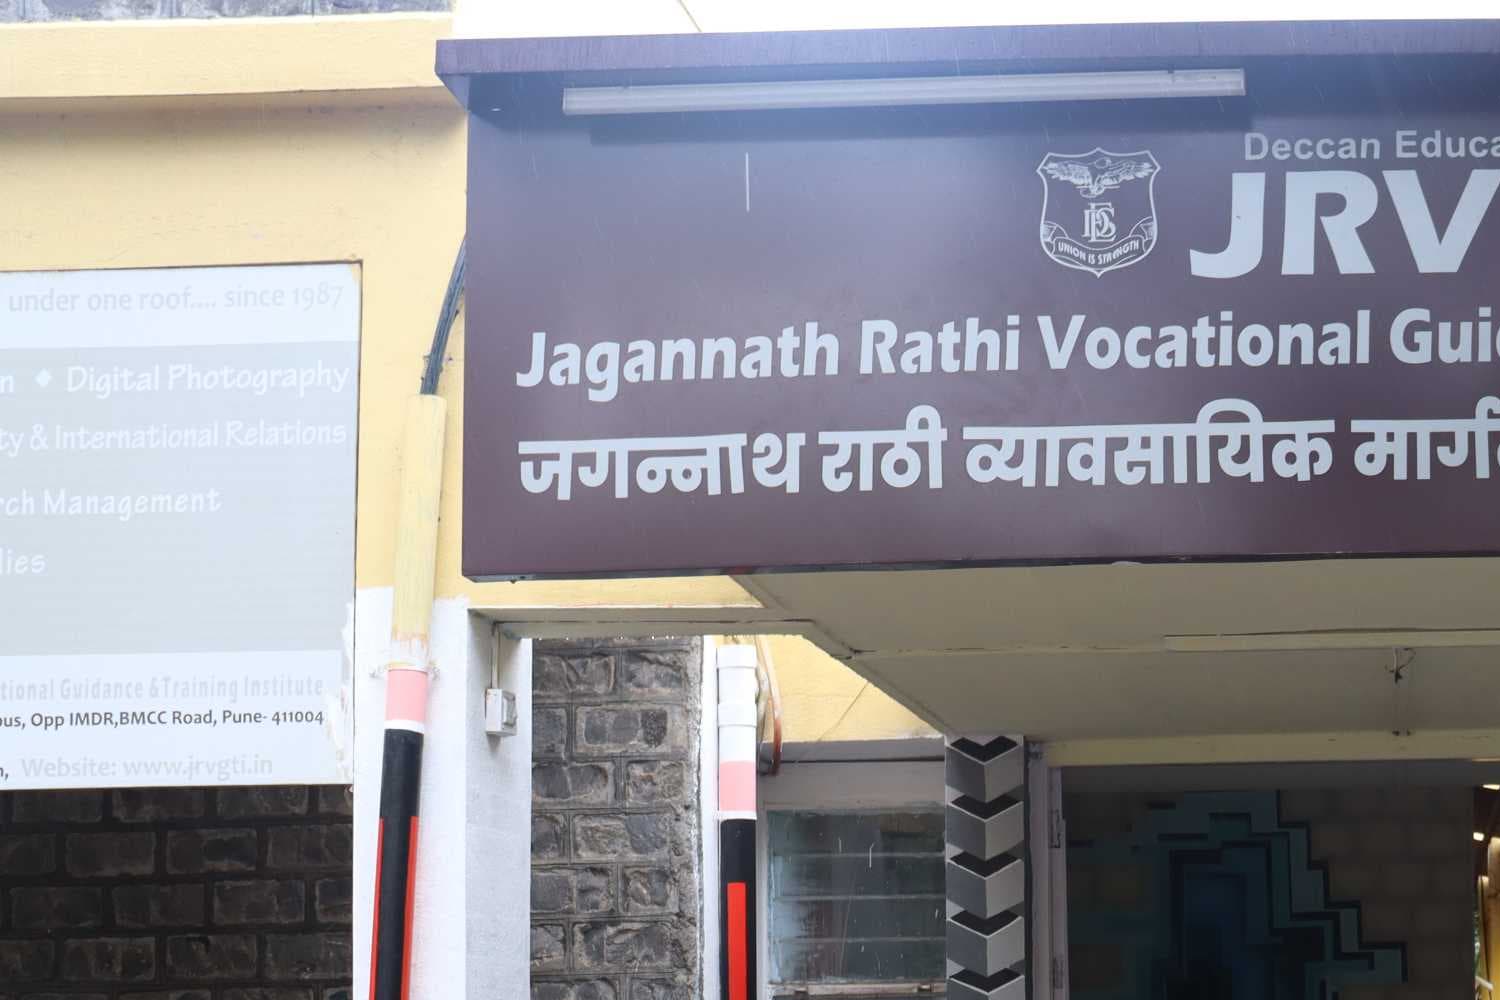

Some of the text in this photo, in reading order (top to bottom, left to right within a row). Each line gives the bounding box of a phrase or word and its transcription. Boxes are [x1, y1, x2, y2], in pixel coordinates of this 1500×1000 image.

[1244, 132, 1381, 161] Deccan
[1058, 241, 1087, 261] UNION
[1088, 253, 1096, 265] IS
[8, 287, 81, 313] under
[87, 290, 132, 312] one
[223, 283, 286, 308] since
[291, 281, 345, 310] 1987
[516, 321, 840, 403] Jagannath
[859, 314, 1020, 375] Rathi
[1036, 309, 1371, 370] Vocational
[66, 364, 160, 400] Digital
[167, 359, 351, 398] Photography
[29, 422, 49, 451] &
[54, 421, 219, 450] International
[224, 417, 347, 448] Relations
[518, 432, 806, 501] जगन्नाथ
[817, 404, 948, 493] राठी
[962, 398, 1335, 488] व्यावसायिक
[42, 487, 222, 522] Management
[59, 677, 144, 701] Guidance
[243, 674, 324, 697] Institute
[30, 712, 65, 731] Opp
[172, 709, 218, 728] Road,
[271, 710, 325, 726] 411004
[21, 755, 118, 778] Website:
[124, 753, 274, 782] www.jrvgti.in
